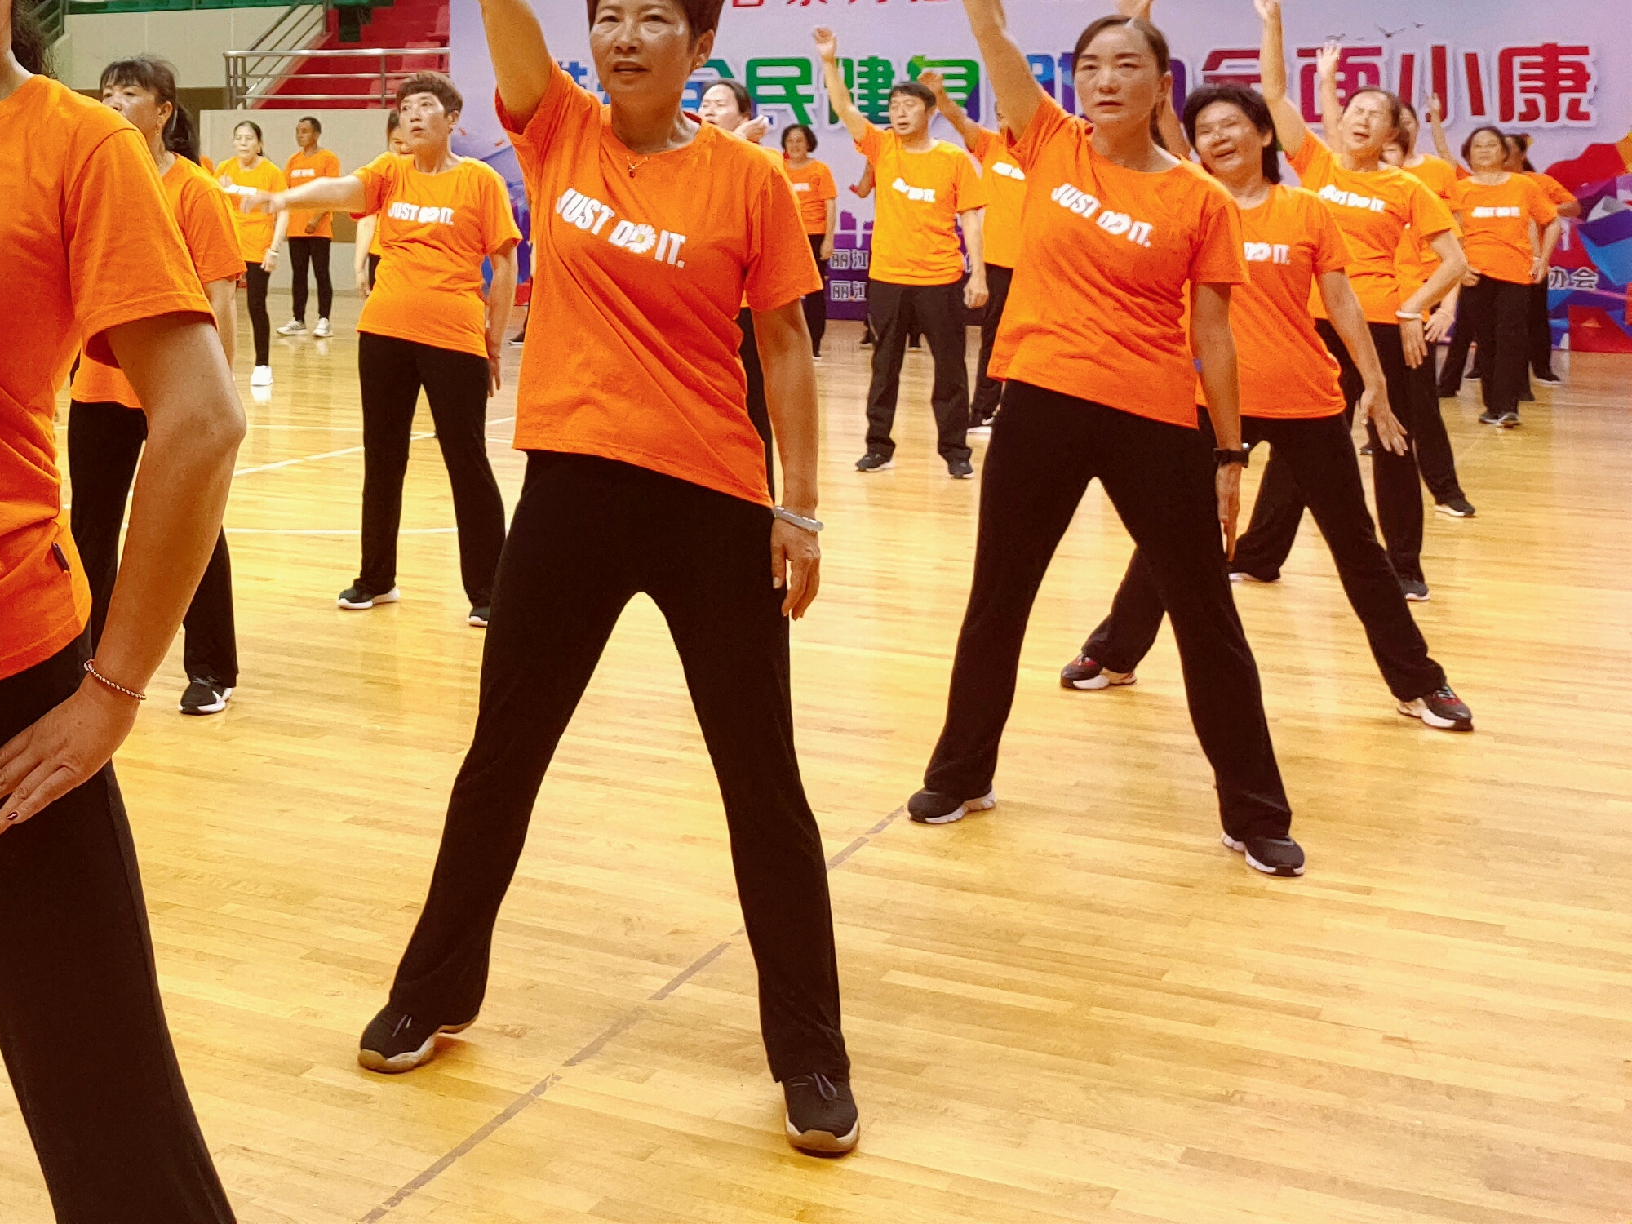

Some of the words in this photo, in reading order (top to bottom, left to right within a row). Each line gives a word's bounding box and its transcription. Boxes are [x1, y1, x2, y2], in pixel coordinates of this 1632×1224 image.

[556, 188, 615, 235] JUST
[654, 229, 686, 268] IT.
[1051, 183, 1102, 218] JUST
[1127, 220, 1153, 247] IT.
